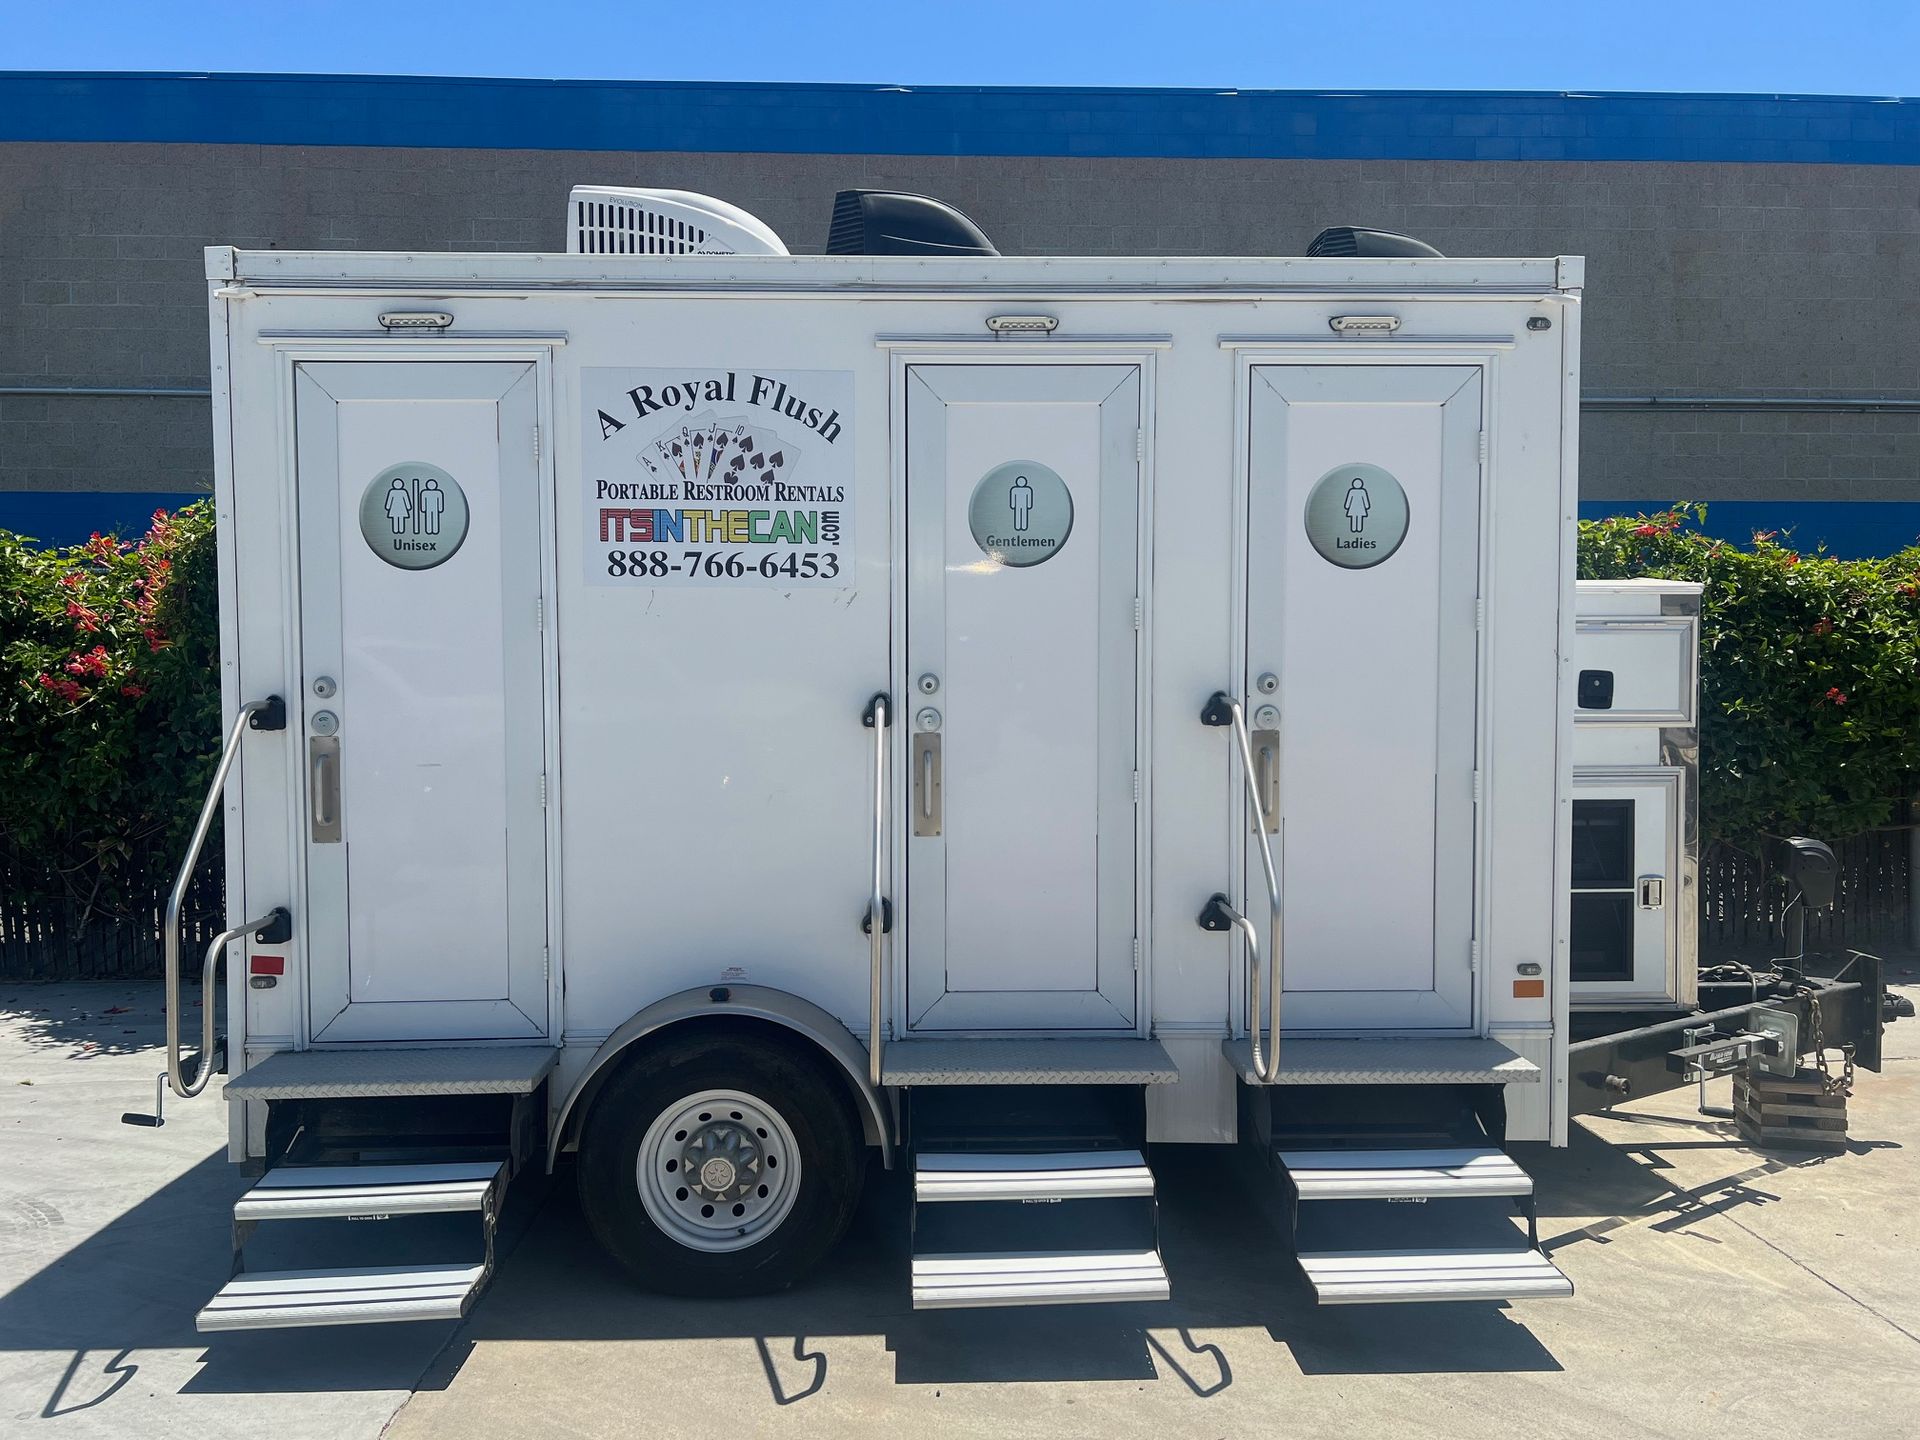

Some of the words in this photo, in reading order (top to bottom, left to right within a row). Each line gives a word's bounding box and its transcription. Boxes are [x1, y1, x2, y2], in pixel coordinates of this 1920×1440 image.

[609, 196, 643, 208] EVOLUTION
[597, 408, 626, 441] A
[626, 372, 736, 419] Royal
[747, 374, 842, 444] Flush
[596, 479, 679, 500] PORTABLE
[683, 480, 770, 502] RESTROOM
[774, 481, 844, 503] RENTALS
[600, 508, 818, 544] ITSINTHECAN
[393, 539, 437, 551] Unisex
[986, 535, 1056, 547] Gentlemen
[1336, 537, 1377, 549] Ladies
[607, 550, 840, 579] 888-766-6453
